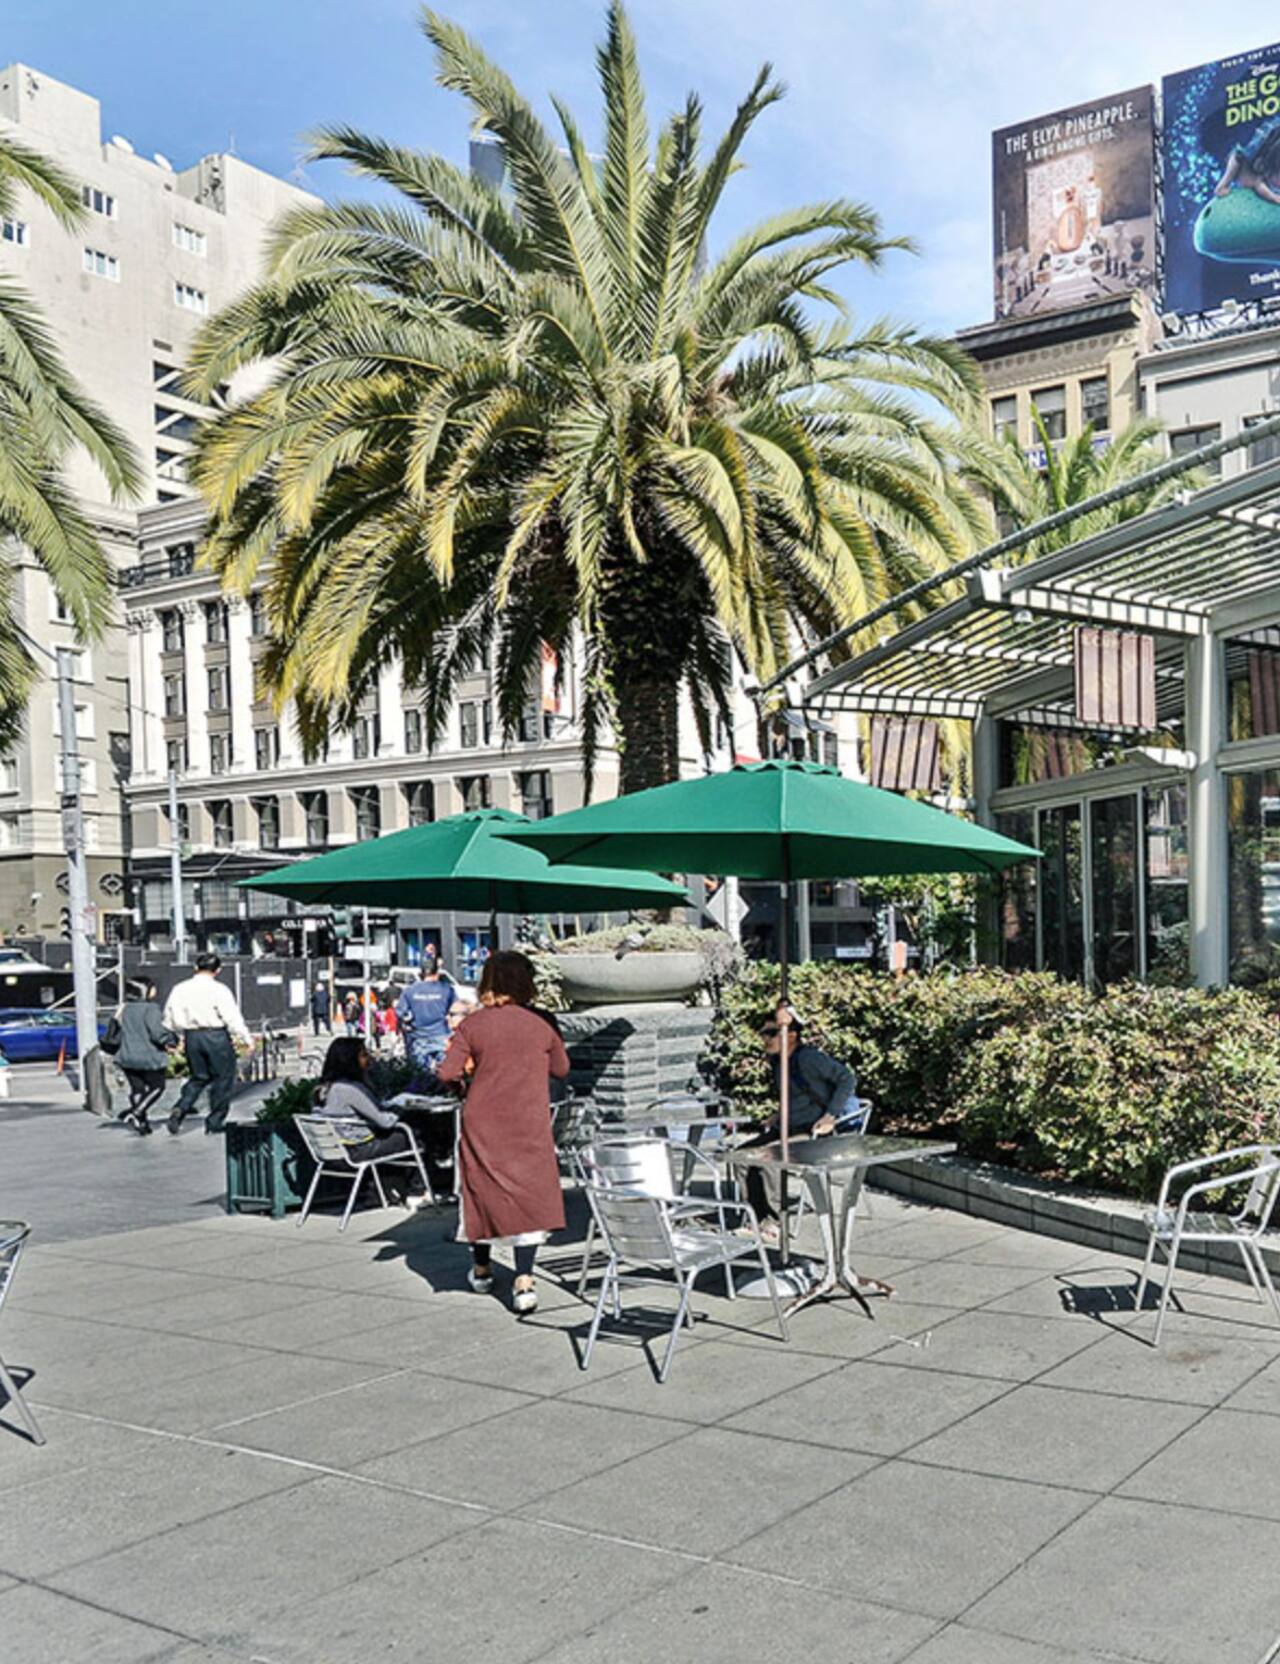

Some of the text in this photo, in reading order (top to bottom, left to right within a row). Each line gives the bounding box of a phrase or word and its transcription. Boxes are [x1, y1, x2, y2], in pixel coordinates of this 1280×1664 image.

[1226, 79, 1258, 99] THE
[1005, 132, 1029, 155] THE
[1031, 123, 1062, 146] ELYX
